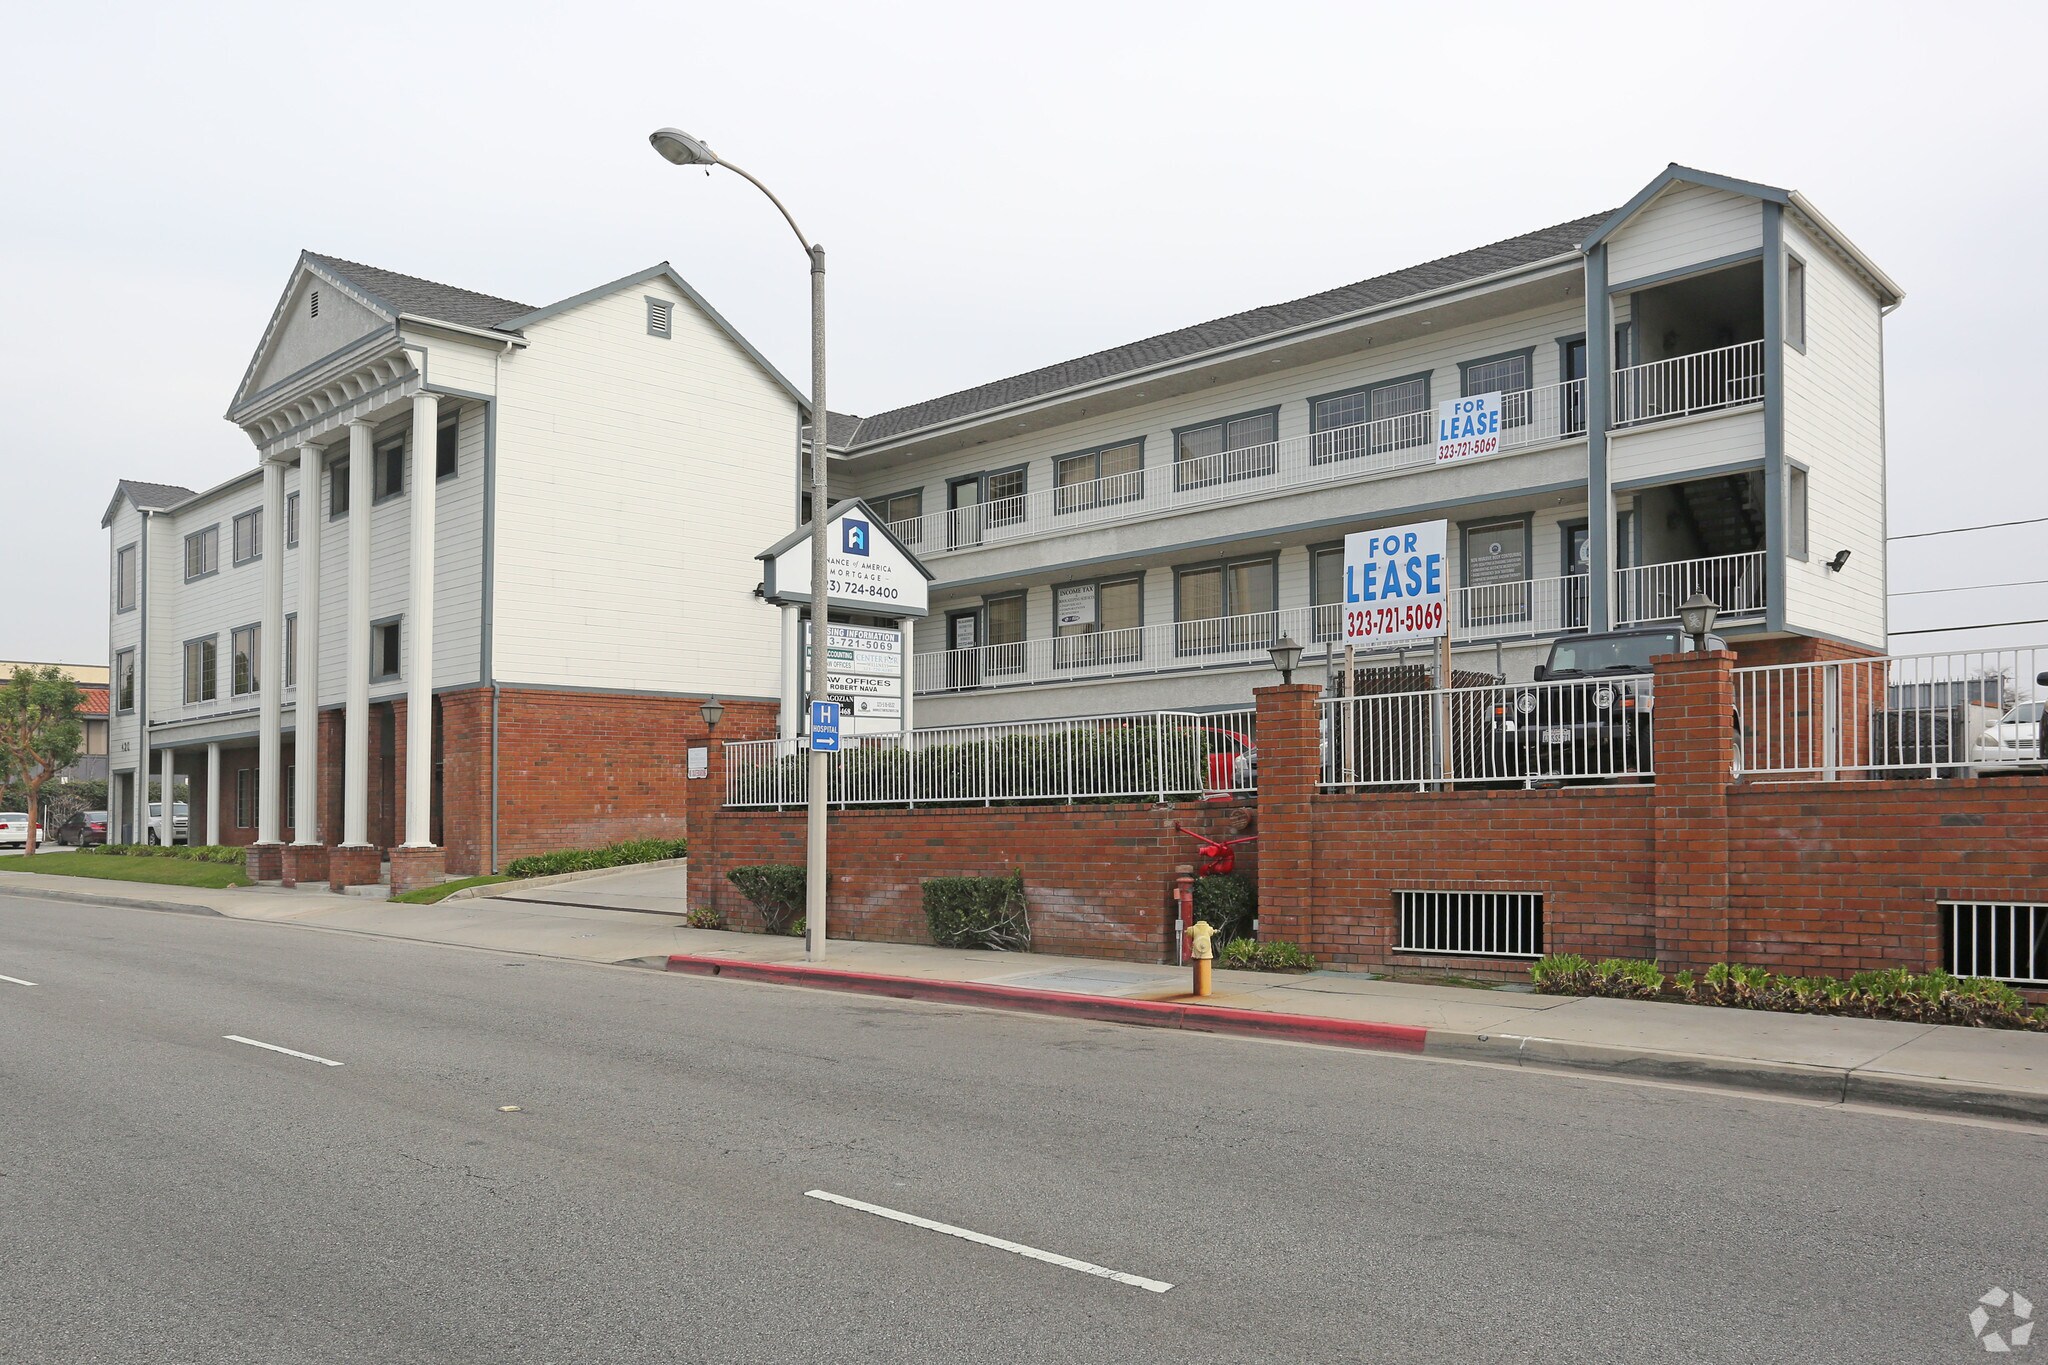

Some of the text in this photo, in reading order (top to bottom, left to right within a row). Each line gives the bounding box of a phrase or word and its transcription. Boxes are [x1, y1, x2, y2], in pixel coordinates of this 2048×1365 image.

[1454, 398, 1485, 415] FOR
[1440, 410, 1499, 441] LEASE
[1438, 437, 1497, 460] 323-721-5069
[1369, 532, 1418, 558] FOR
[827, 557, 850, 567] NANCE
[862, 563, 892, 573] AMERICA
[830, 569, 881, 581] MORTGAGE
[1347, 553, 1441, 604] LEASE
[845, 581, 898, 599] 724-8400
[1060, 585, 1094, 597] INCOME TAX
[1347, 602, 1443, 637] 323-721-5069
[827, 628, 895, 642] SING INFORMATION
[829, 637, 893, 651] 3-721-5069
[827, 650, 853, 660] CCOUNTING
[856, 653, 883, 663] CENTER
[834, 661, 851, 669] OFFICES
[830, 683, 857, 691] ROBERT
[845, 677, 891, 687] OFFICES
[827, 694, 854, 702] AGOZIAN
[821, 705, 831, 723] H
[813, 724, 838, 734] HOSPITAL
